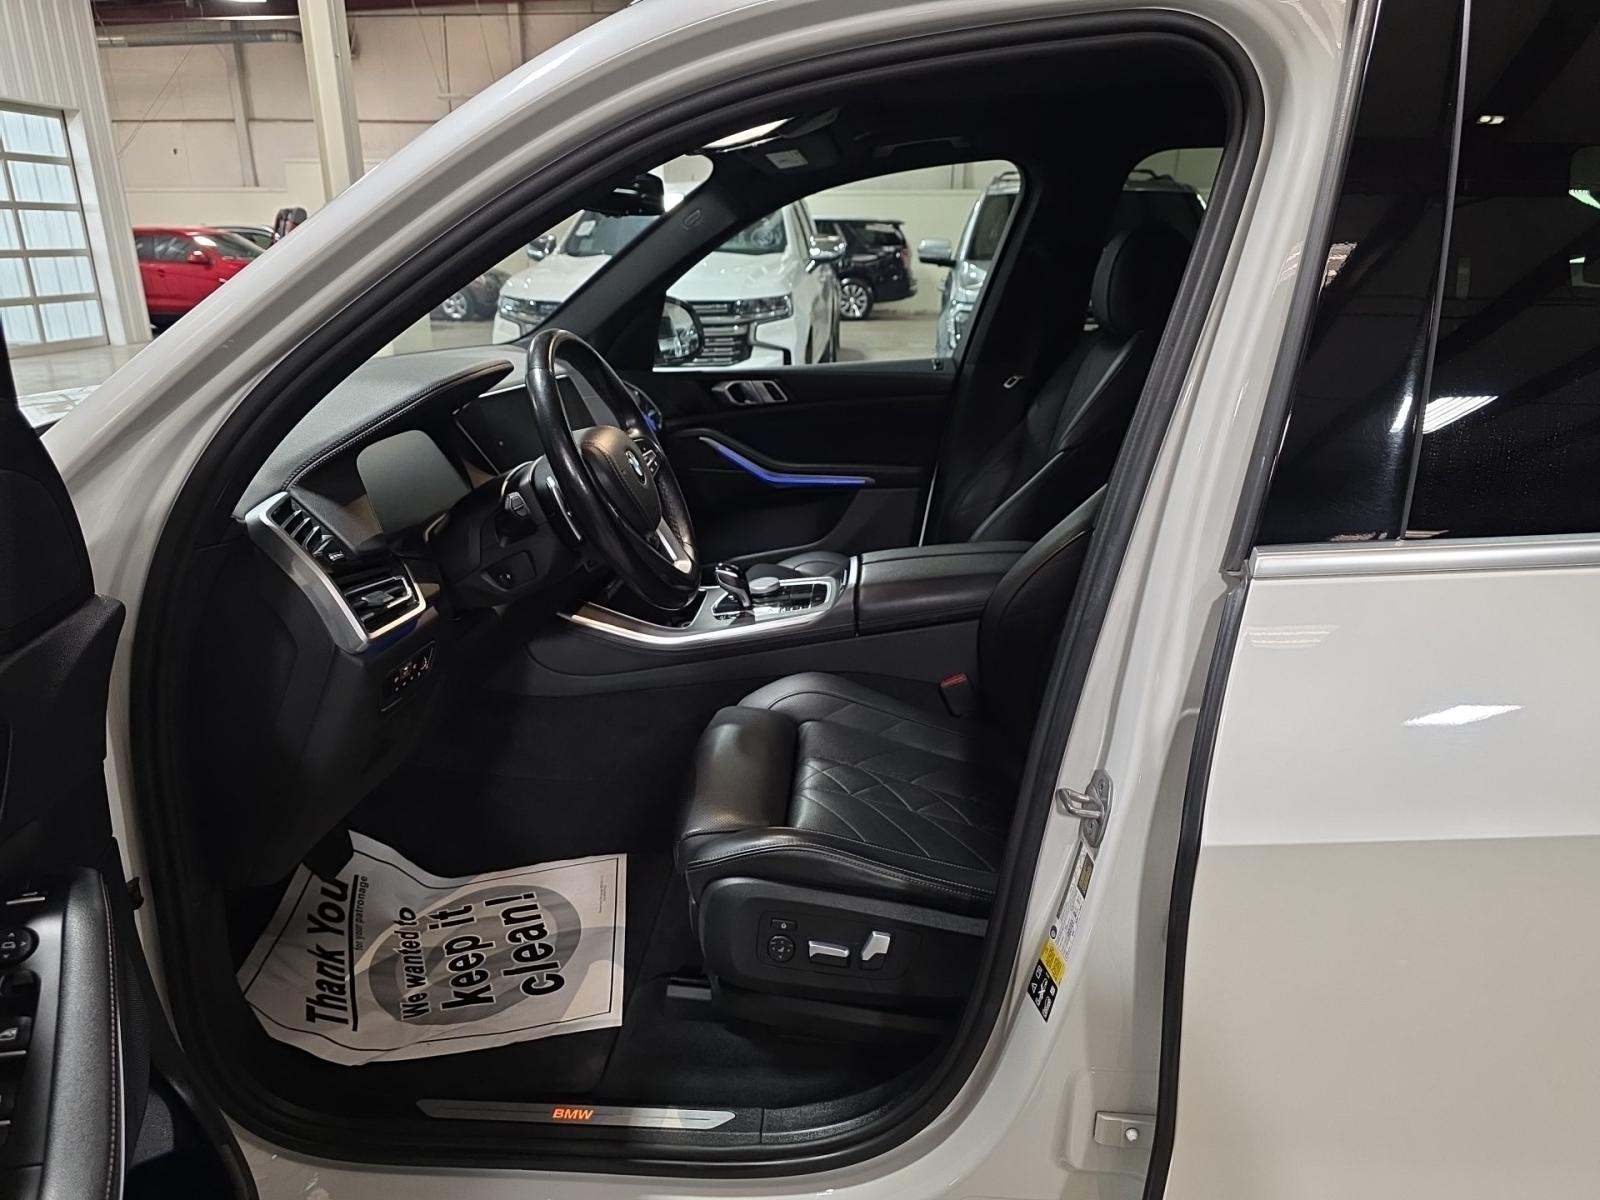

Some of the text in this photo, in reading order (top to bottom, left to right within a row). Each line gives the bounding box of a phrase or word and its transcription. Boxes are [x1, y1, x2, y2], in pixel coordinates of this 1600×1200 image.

[306, 877, 349, 1025] Thank You
[352, 875, 369, 951] for your patronage
[393, 906, 430, 1019] We wanted to
[427, 904, 496, 1010] keep it
[484, 892, 565, 996] clean!
[551, 1107, 594, 1120] BMW
